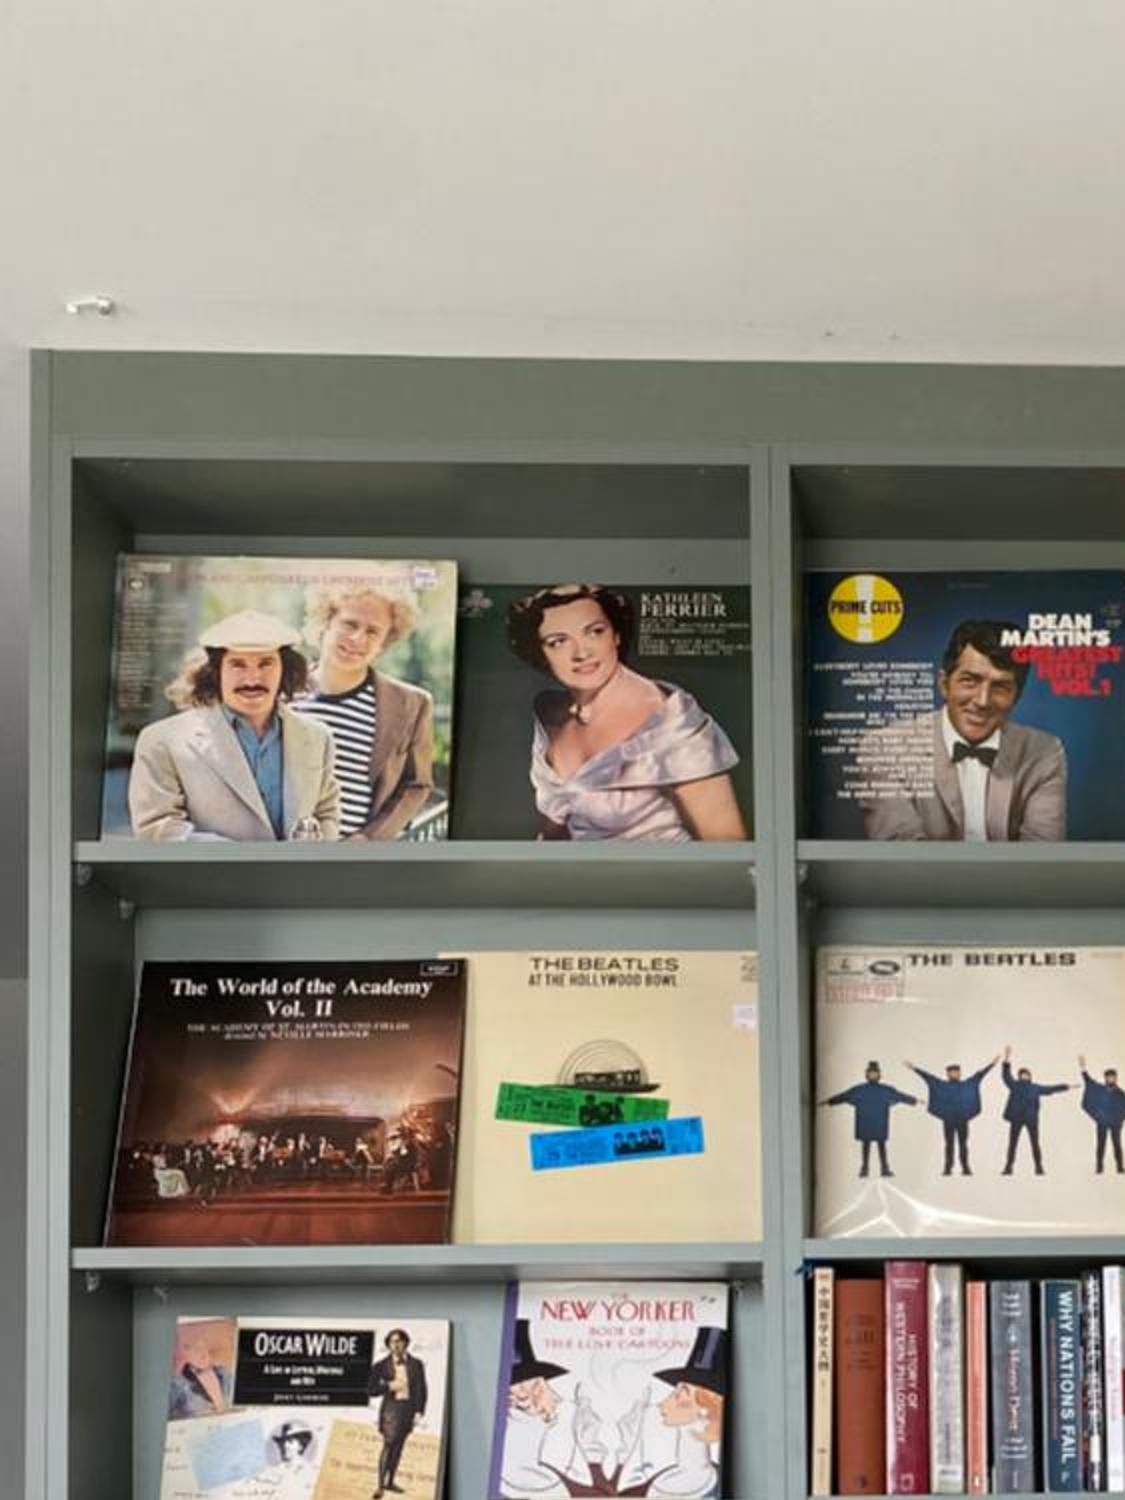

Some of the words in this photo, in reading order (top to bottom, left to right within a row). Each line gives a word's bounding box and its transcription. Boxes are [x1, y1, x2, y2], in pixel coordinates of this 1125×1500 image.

[641, 592, 722, 602] KATHLEEN
[641, 604, 727, 617] FERRIER
[832, 601, 868, 615] PRIME
[871, 600, 901, 614] CUTS
[1028, 613, 1092, 630] DEAN
[1001, 631, 1110, 647] MARTIN'S
[531, 957, 574, 971] THE
[577, 957, 679, 971] BEATLES
[906, 953, 953, 966] THE
[964, 953, 1076, 966] BEATLES
[528, 973, 542, 986] AT
[545, 973, 566, 986] THE
[569, 973, 642, 986] HOLLYWOOD
[645, 974, 677, 986] BOWL
[171, 979, 208, 996] The
[218, 979, 277, 995] World
[282, 978, 302, 994] of
[306, 978, 336, 994] the
[343, 979, 433, 998] Academy
[265, 1001, 305, 1017] Vol.
[314, 1001, 333, 1016] II
[541, 1300, 597, 1320] NEW
[601, 1300, 695, 1321] YORKER
[1058, 1291, 1074, 1332] WHY
[255, 1332, 302, 1356] OSCAR
[305, 1333, 357, 1356] WILDE
[1059, 1337, 1076, 1420] NATIONS
[1060, 1424, 1077, 1463] FAIL
